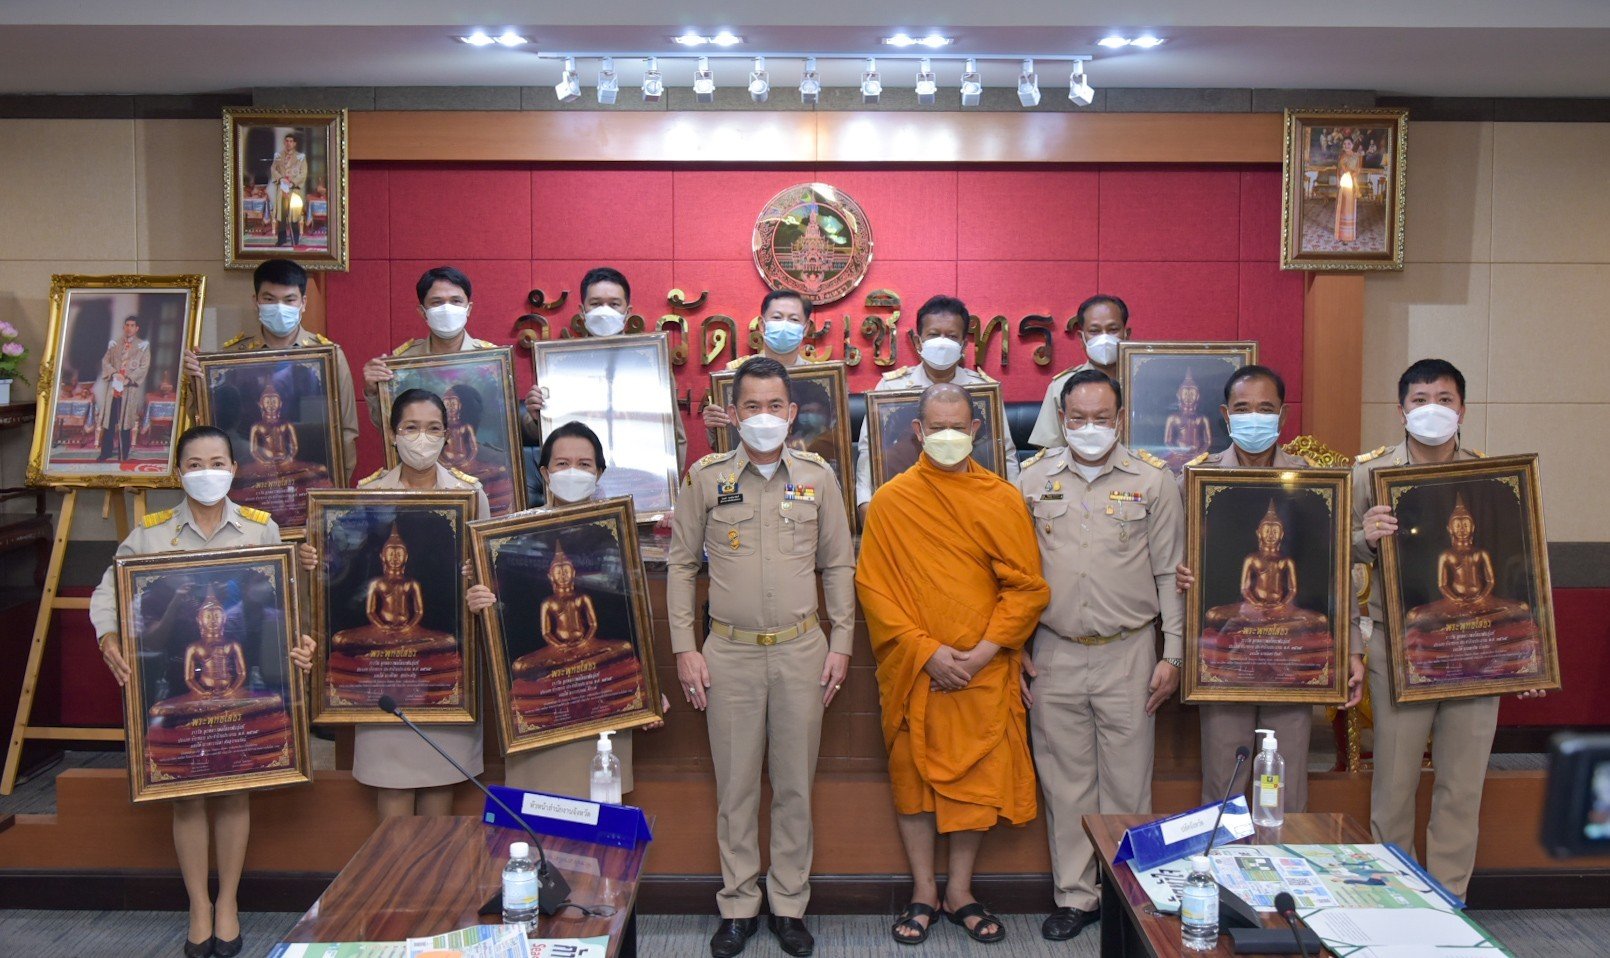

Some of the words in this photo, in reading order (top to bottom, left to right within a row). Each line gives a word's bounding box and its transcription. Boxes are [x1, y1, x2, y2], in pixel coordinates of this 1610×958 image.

[513, 288, 1081, 367] จัวัดะเชิทร
